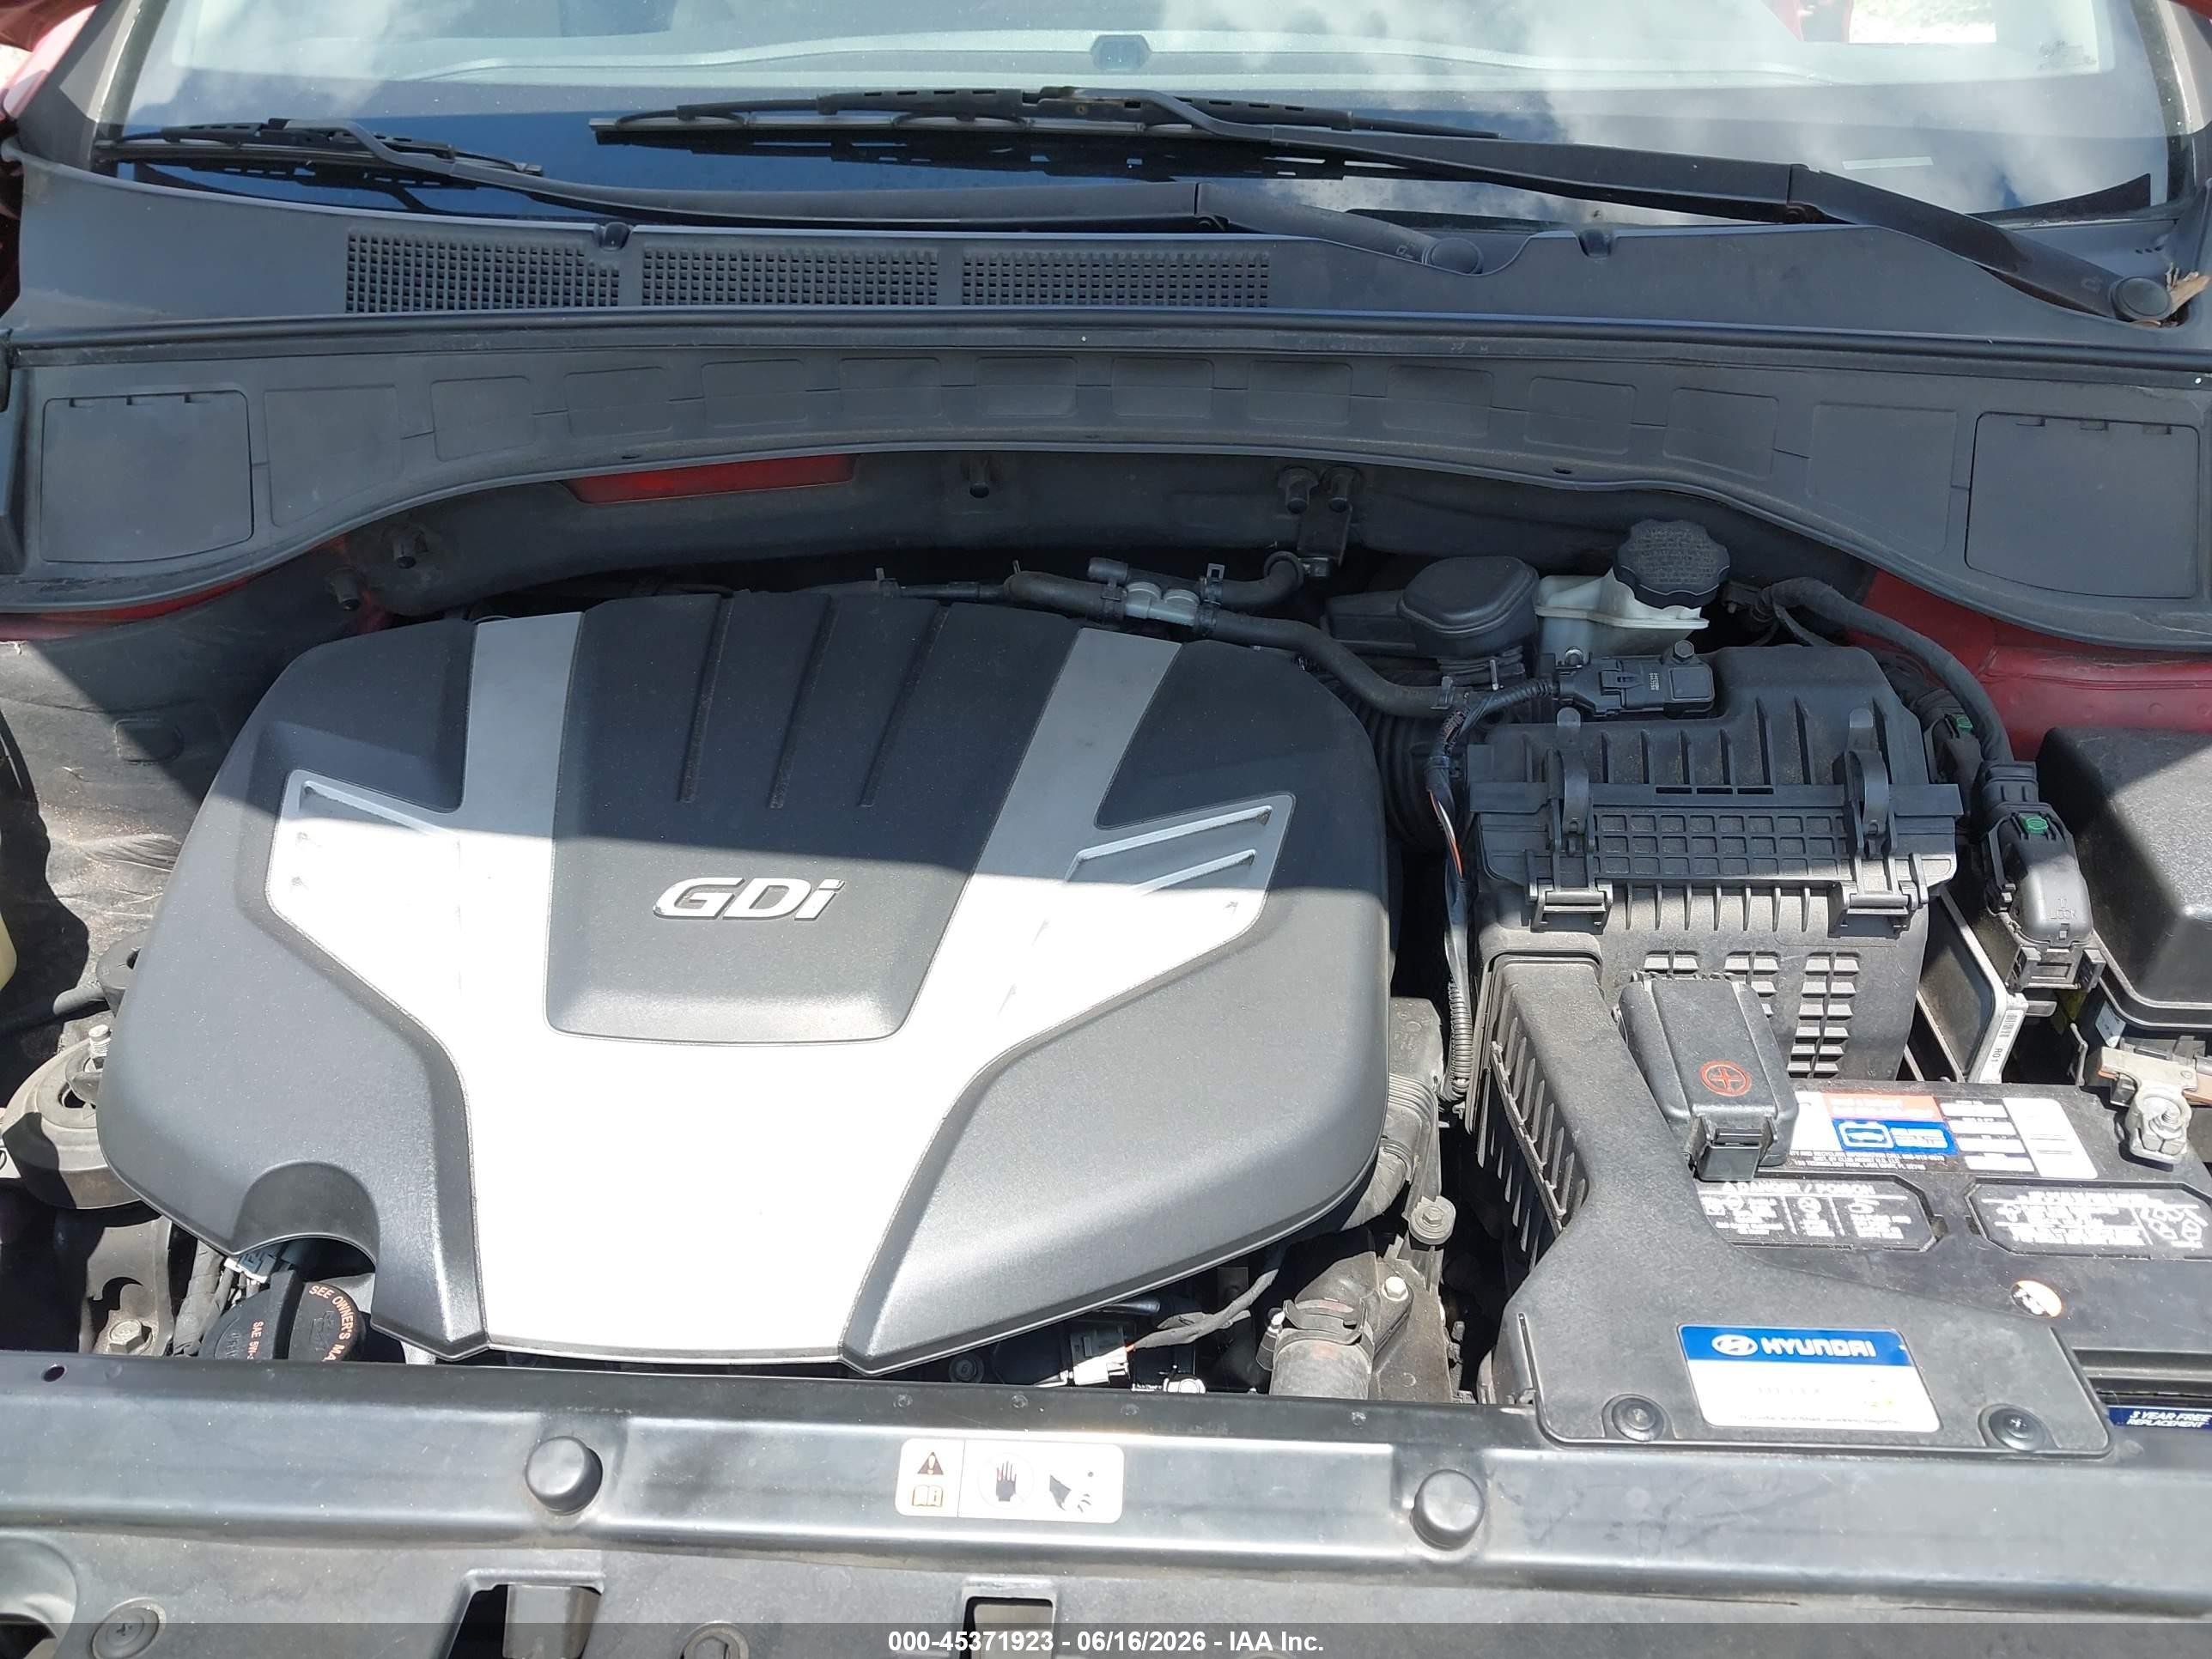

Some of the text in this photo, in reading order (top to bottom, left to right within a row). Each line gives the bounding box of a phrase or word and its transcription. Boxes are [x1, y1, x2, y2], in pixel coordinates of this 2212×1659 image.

[653, 877, 845, 921] GDi
[309, 1285, 335, 1299] SEE
[331, 1296, 355, 1340] OWNER'S
[251, 1321, 264, 1339] SAE
[1760, 1337, 1876, 1357] HYUNDAI
[2126, 1419, 2204, 1428] REPLACEMENT
[2142, 1411, 2177, 1420] YEAR
[2176, 1413, 2212, 1422] FREE
